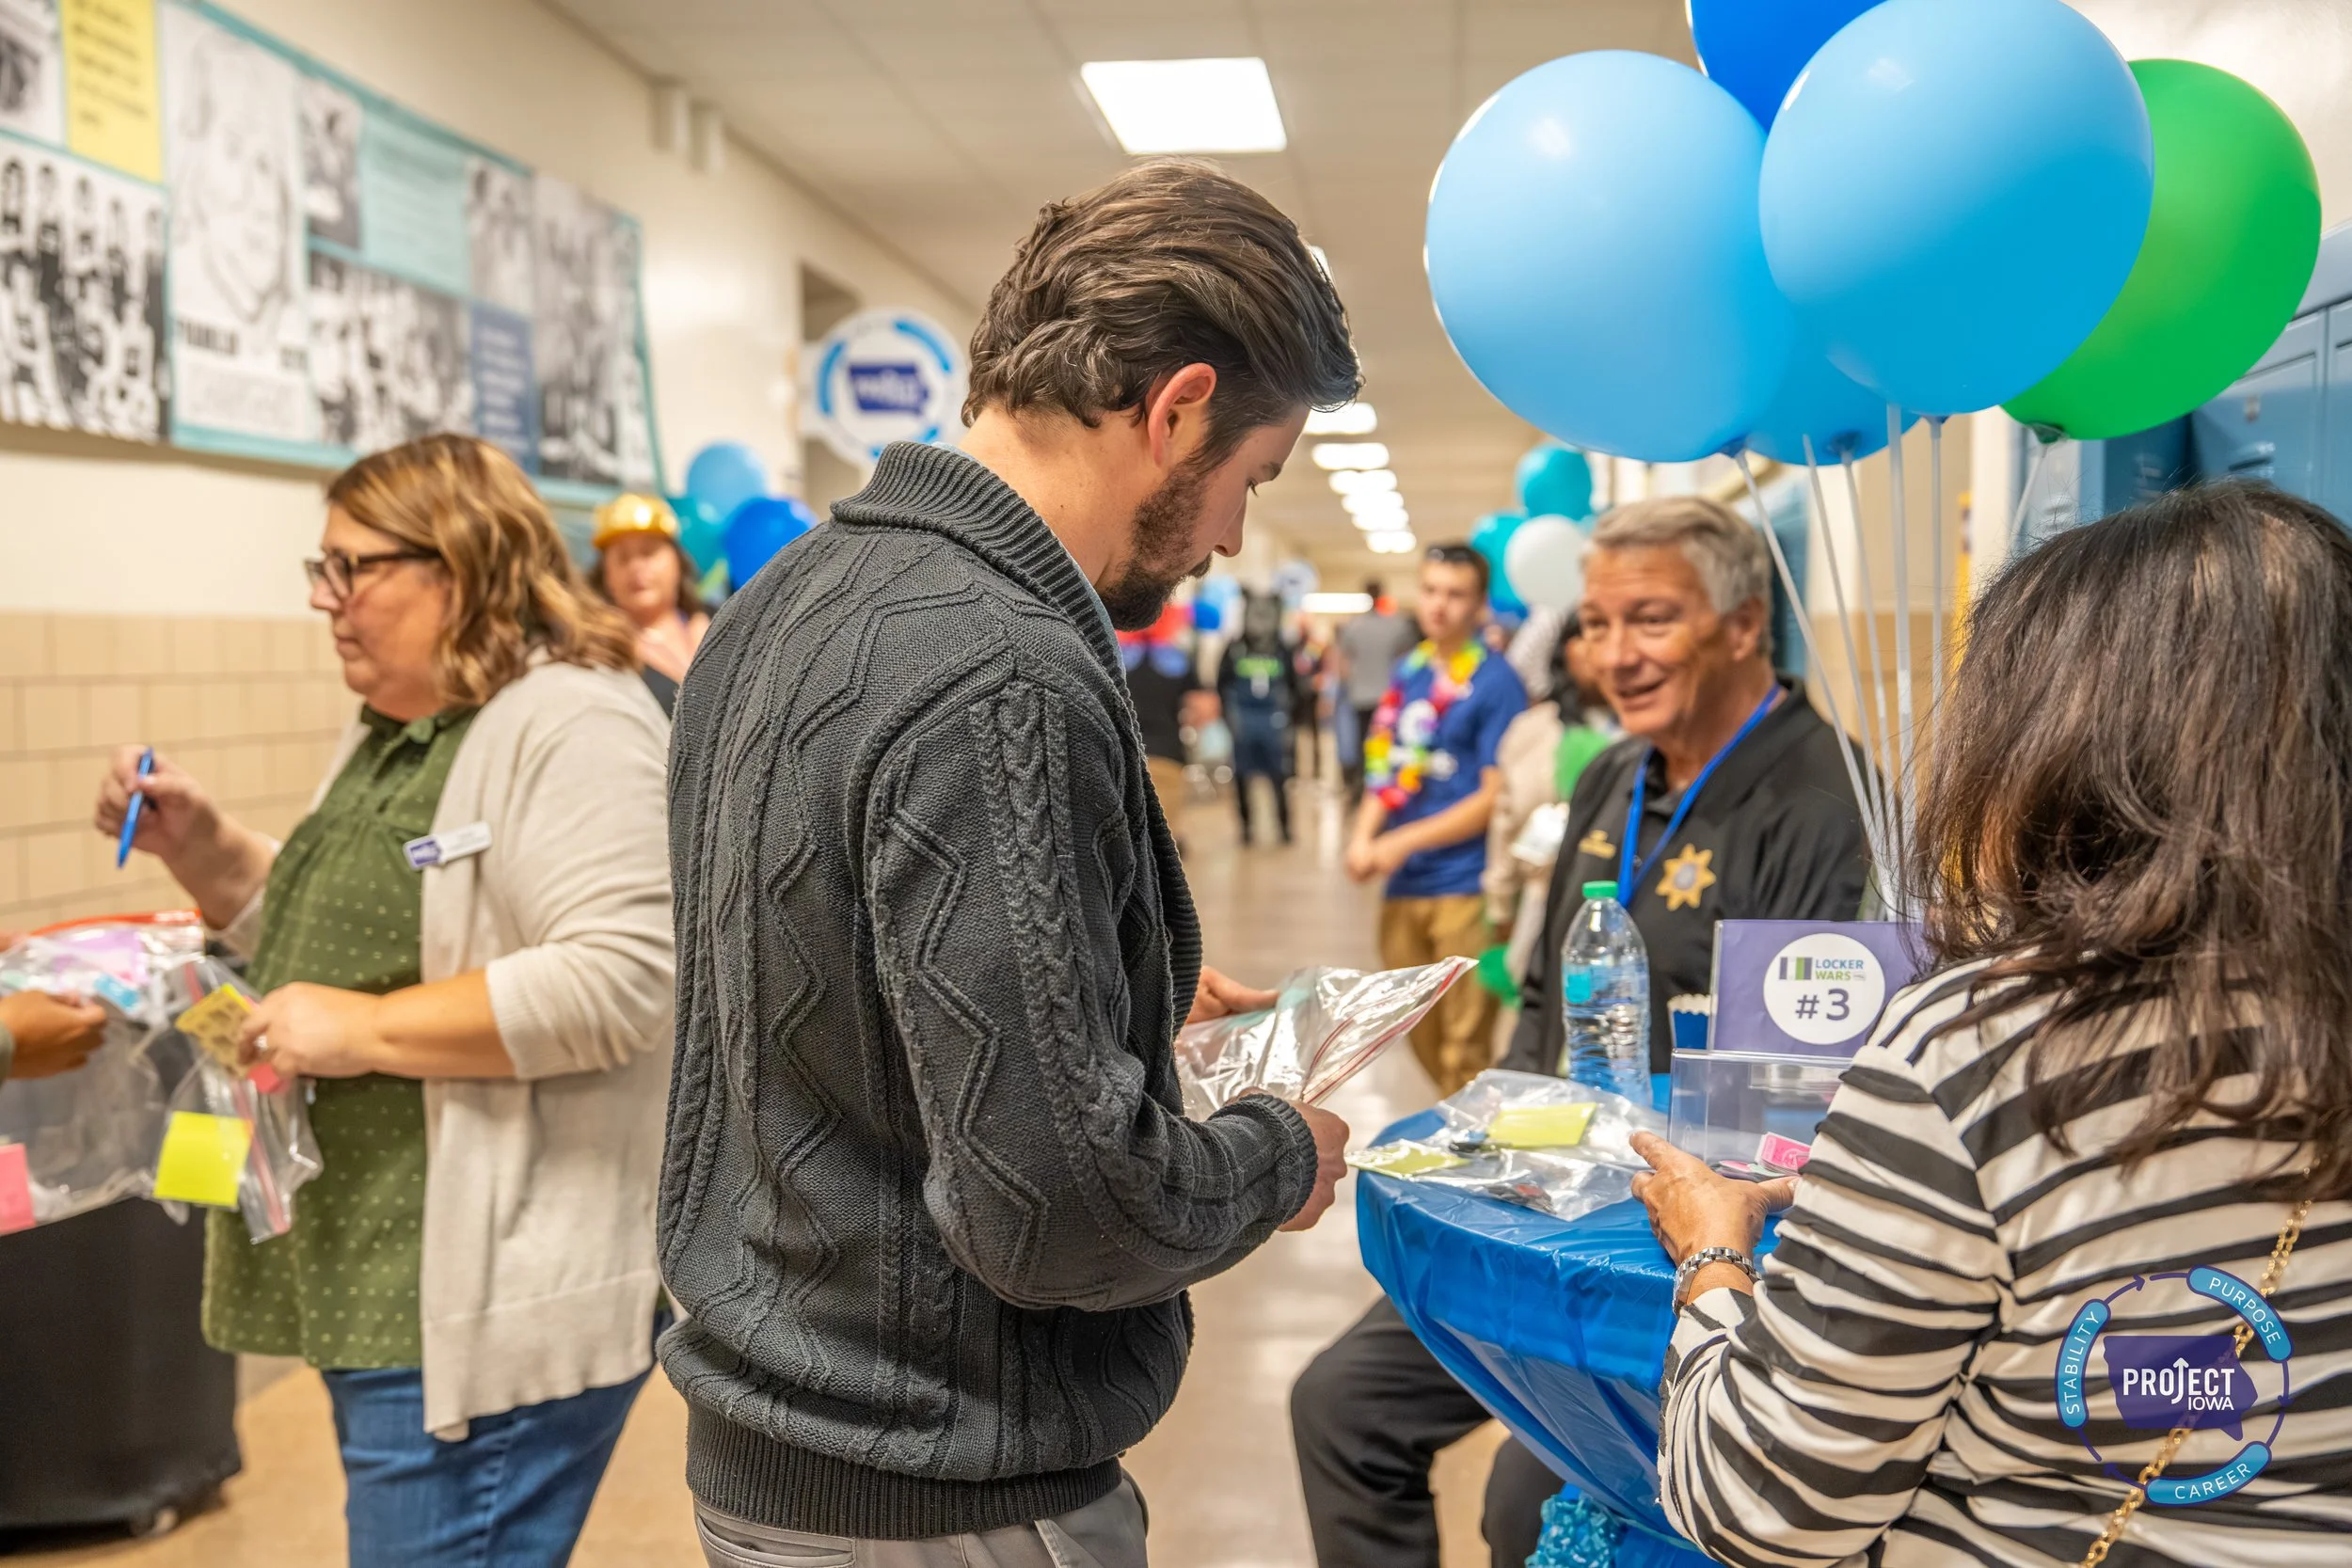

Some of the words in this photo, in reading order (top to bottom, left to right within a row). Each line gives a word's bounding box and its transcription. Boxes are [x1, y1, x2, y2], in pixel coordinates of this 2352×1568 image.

[1816, 958, 1864, 970] LOCKER
[1816, 971, 1851, 981] WARS
[1795, 988, 1850, 1022] #3
